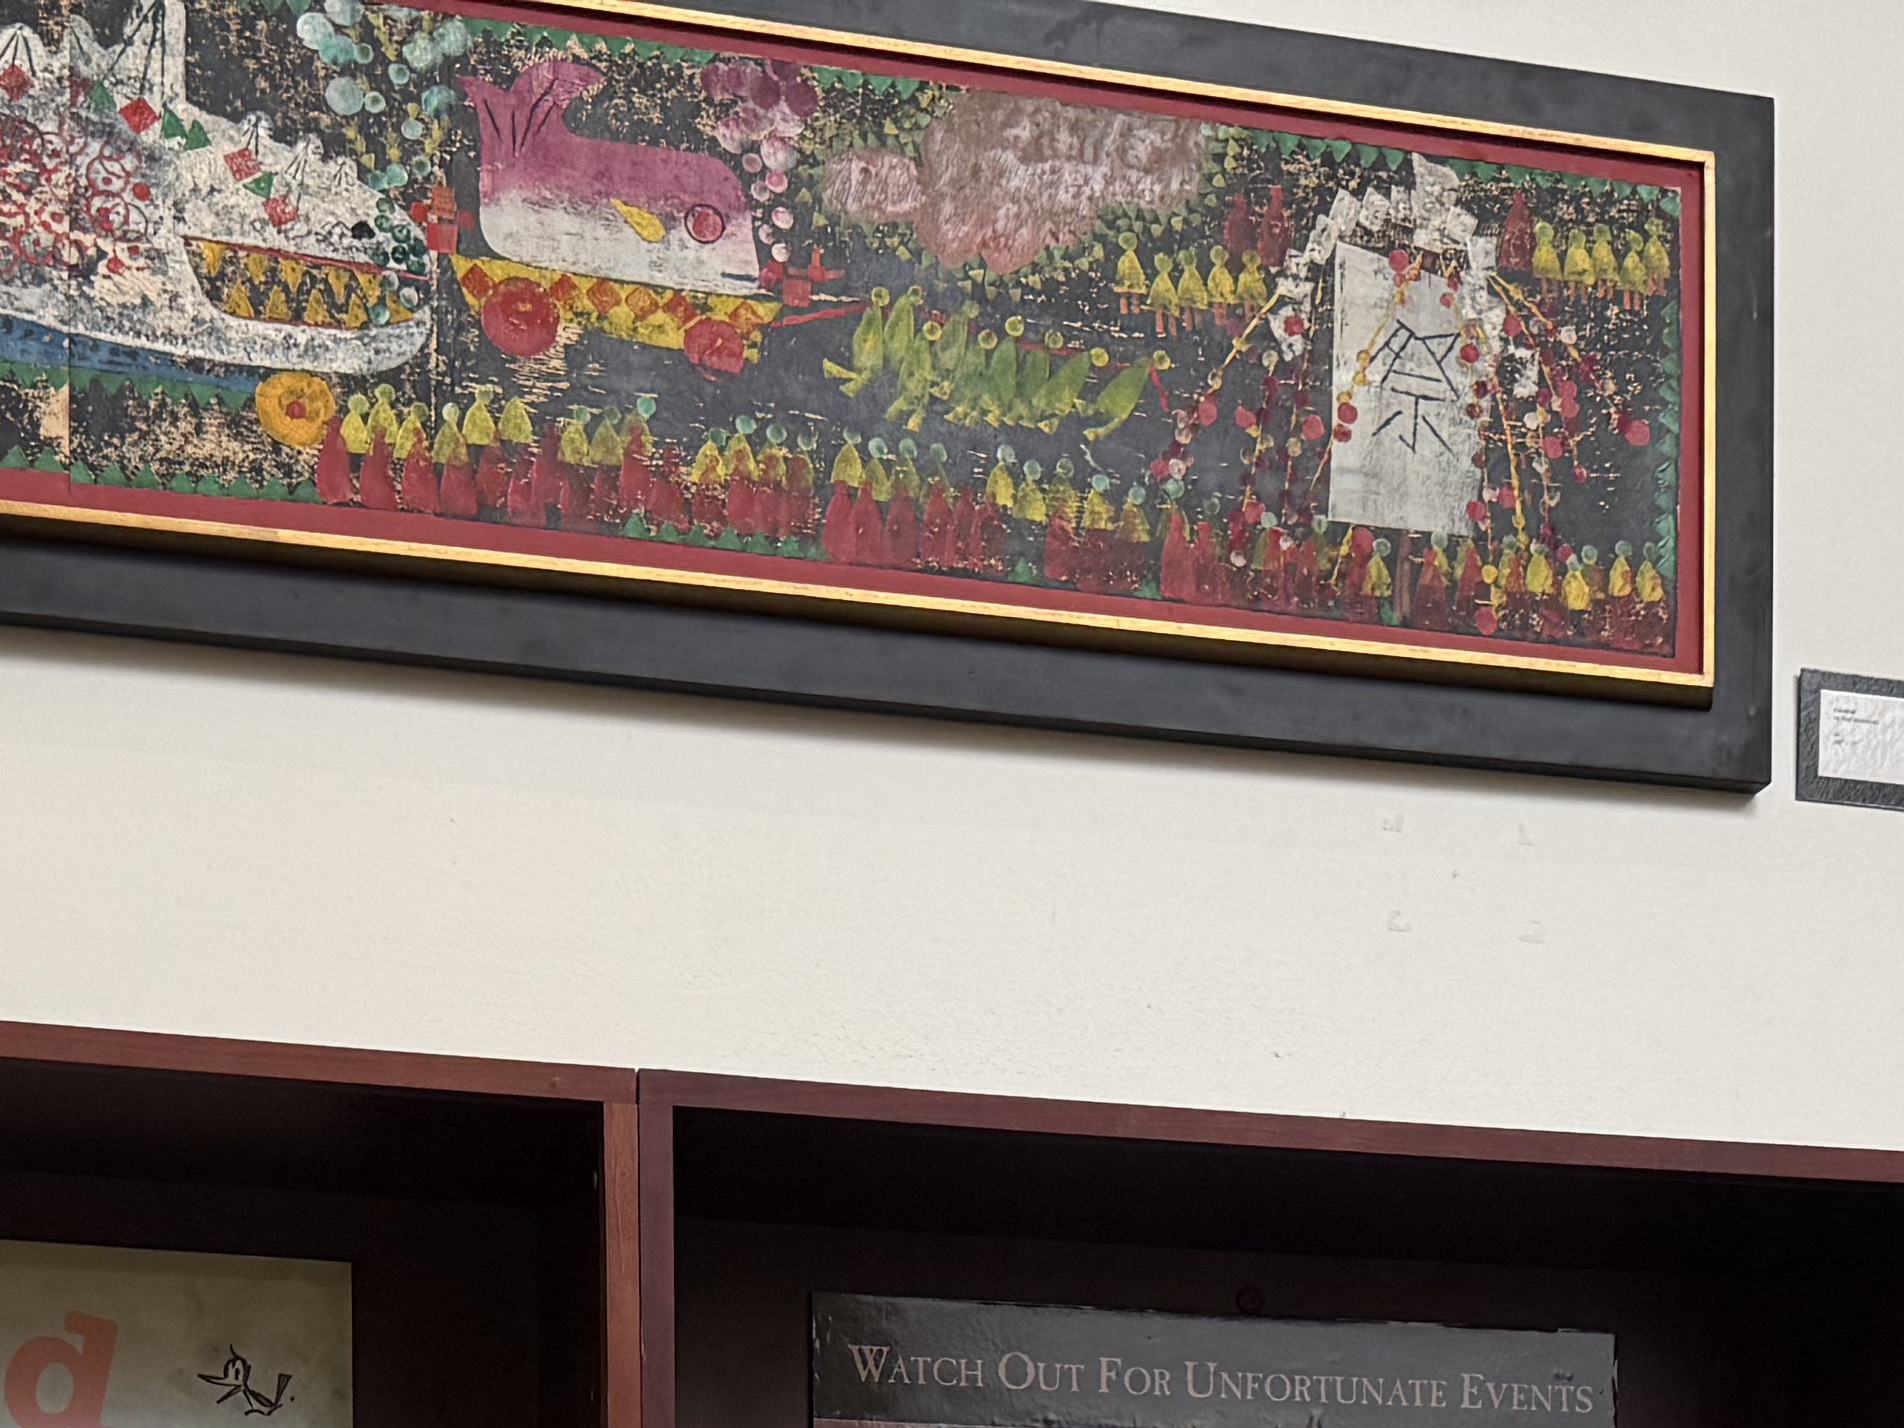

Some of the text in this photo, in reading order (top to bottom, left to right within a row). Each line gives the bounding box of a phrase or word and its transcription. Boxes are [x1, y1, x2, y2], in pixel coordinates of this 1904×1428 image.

[849, 1344, 1594, 1413] WATCH OUT FOR UNFORTUNATE EVENTS
